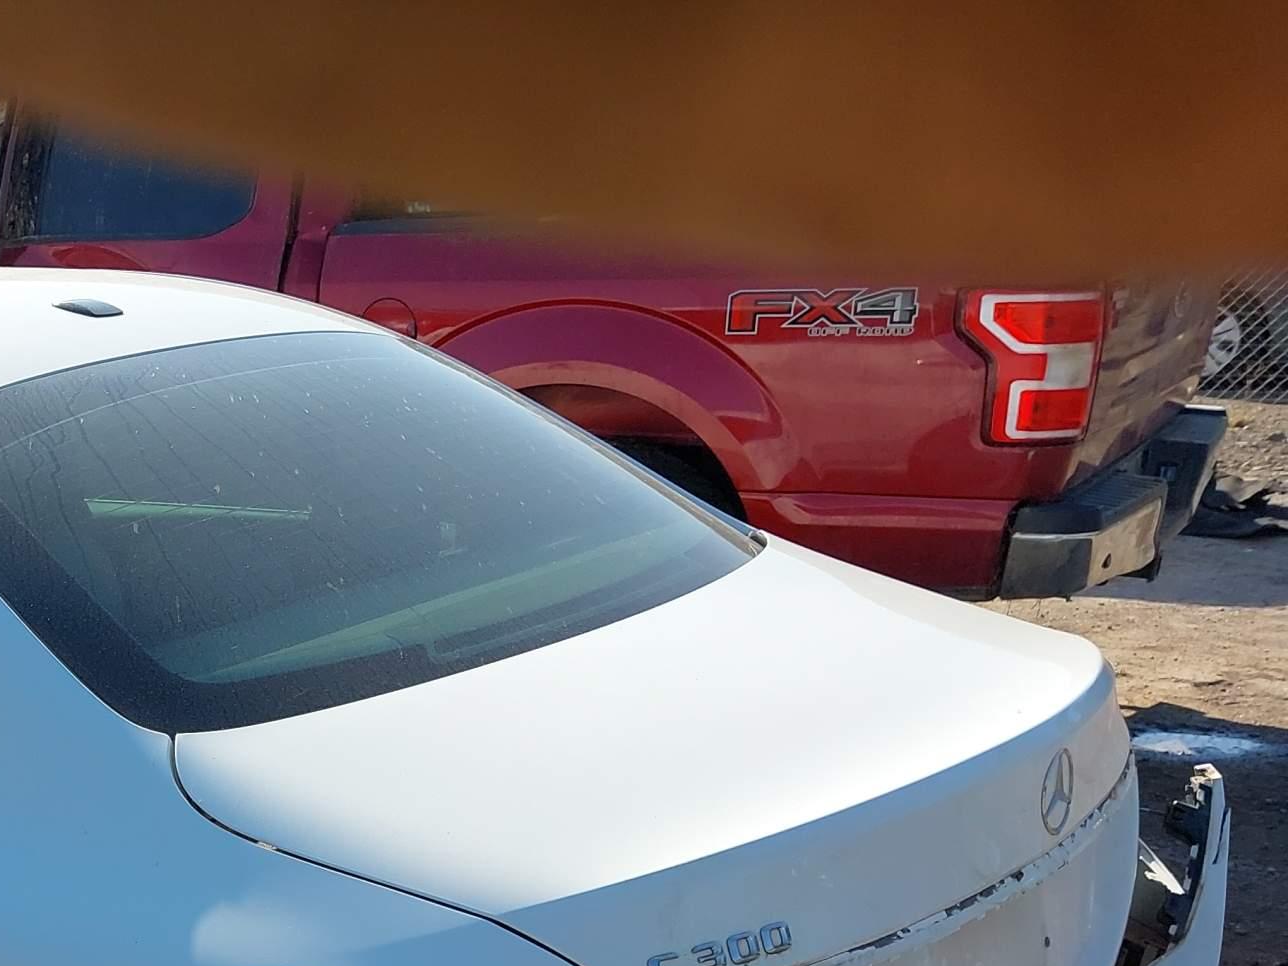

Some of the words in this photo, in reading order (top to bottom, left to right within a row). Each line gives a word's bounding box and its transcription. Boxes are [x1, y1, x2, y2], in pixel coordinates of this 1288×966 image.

[725, 287, 919, 336] FX4
[807, 327, 850, 336] OFF
[856, 326, 914, 336] ROAD
